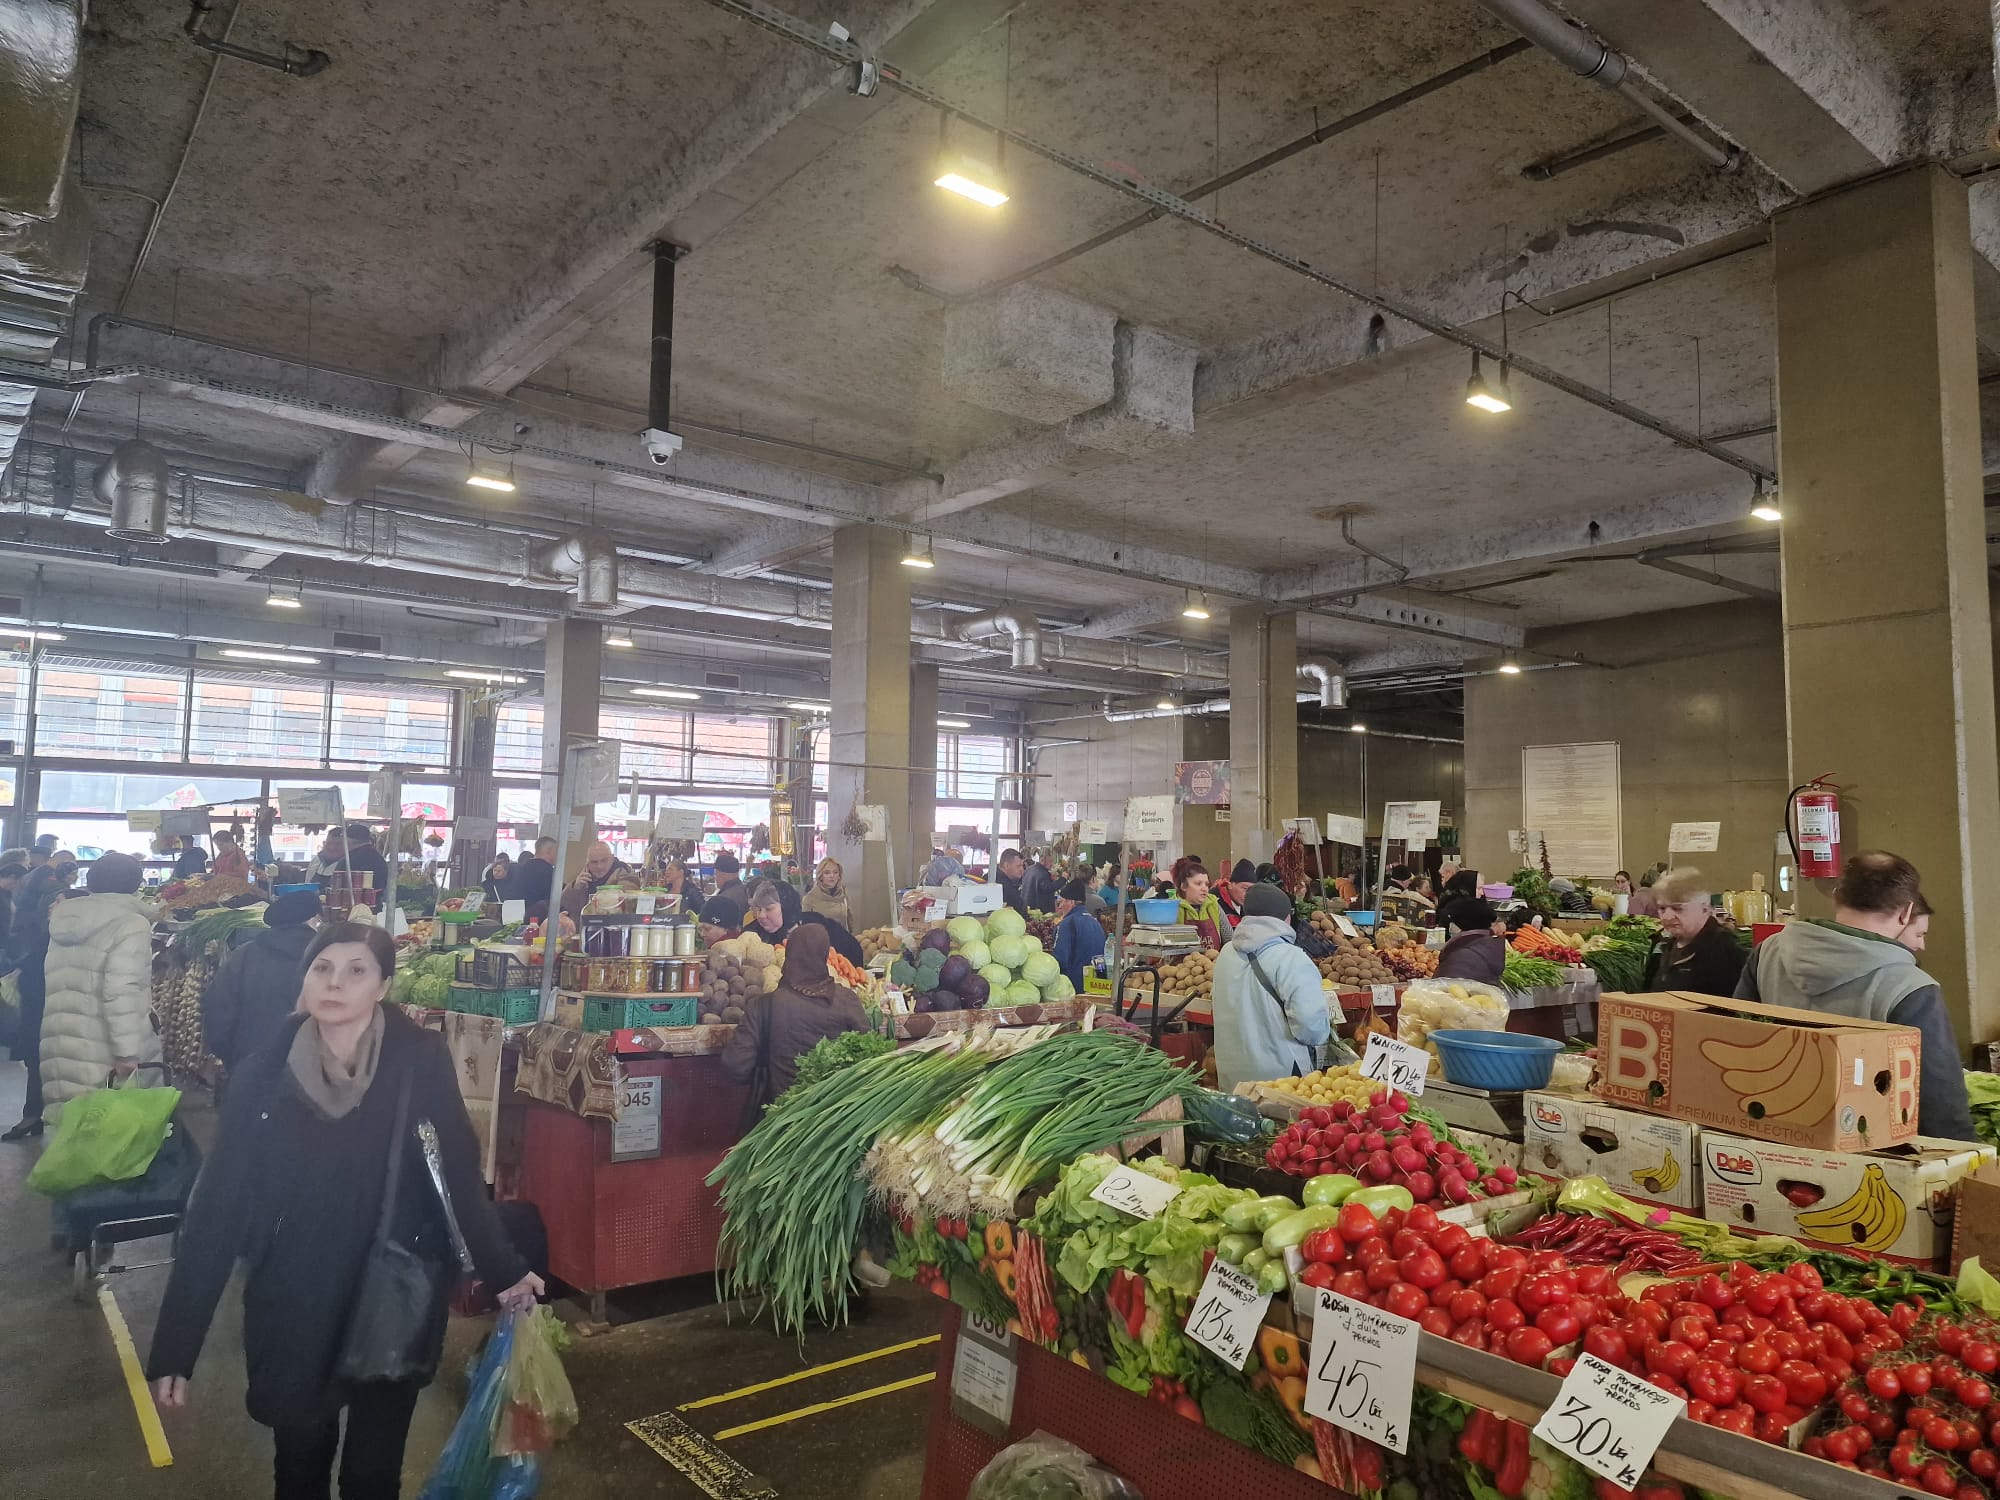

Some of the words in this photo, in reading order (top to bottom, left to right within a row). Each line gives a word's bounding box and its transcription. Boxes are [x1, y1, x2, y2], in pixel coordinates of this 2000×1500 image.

[1600, 1002, 1650, 1021] GOLDEN
[1607, 1015, 1659, 1091] B
[1536, 1106, 1562, 1123] Dole
[1676, 1103, 1737, 1127] PREMIUM
[1739, 1118, 1816, 1145] SELECTION
[1716, 1152, 1754, 1171] Dole
[1191, 1296, 1233, 1341] 13
[1318, 1340, 1382, 1418] 45
[1547, 1396, 1612, 1456] 30
